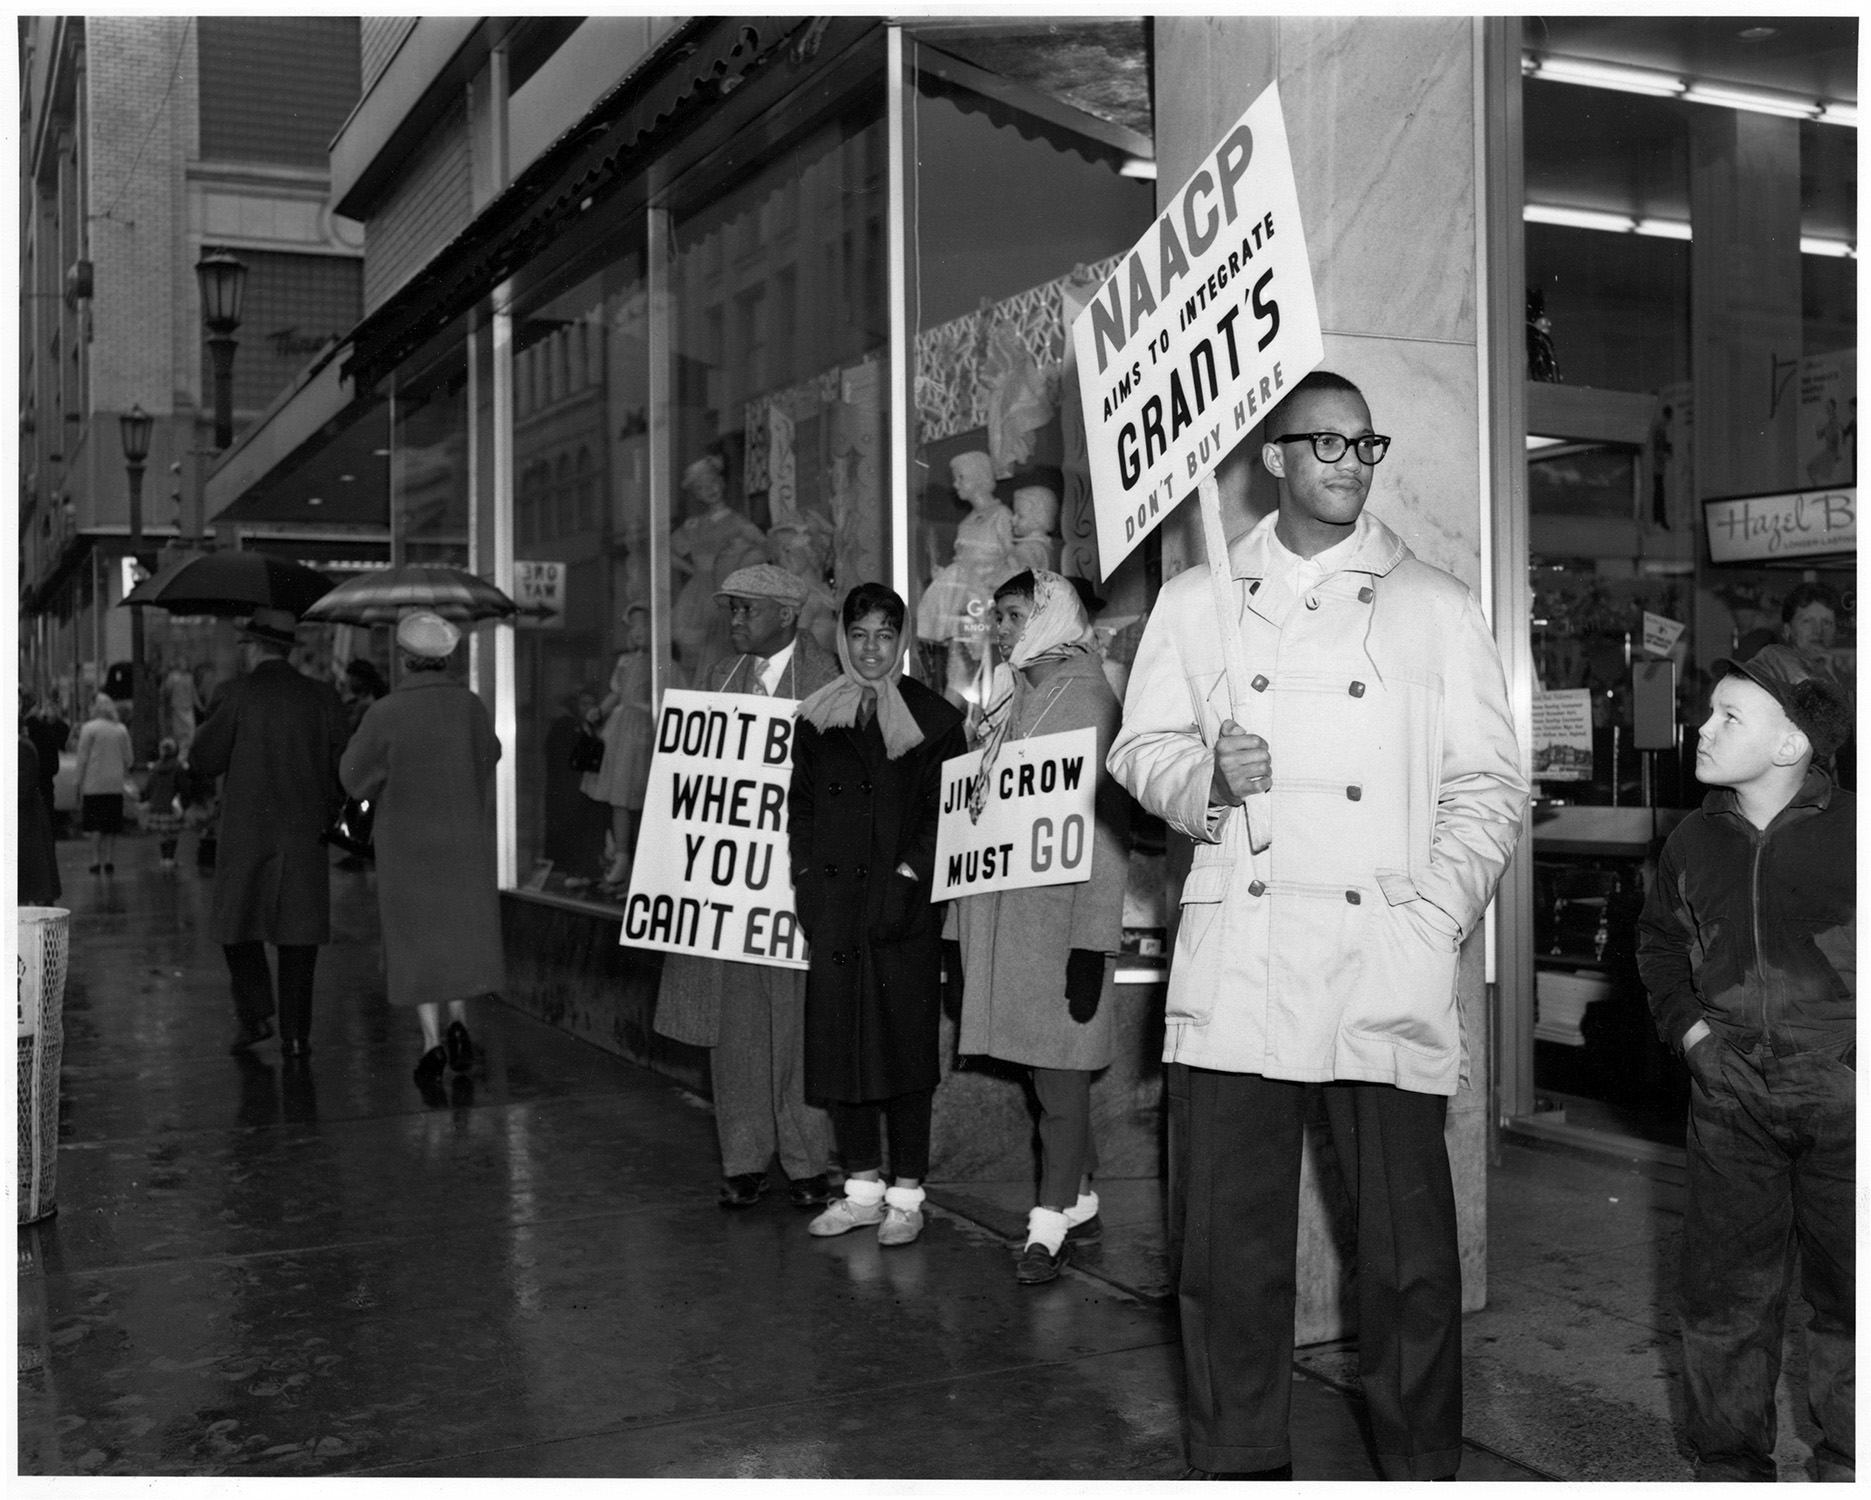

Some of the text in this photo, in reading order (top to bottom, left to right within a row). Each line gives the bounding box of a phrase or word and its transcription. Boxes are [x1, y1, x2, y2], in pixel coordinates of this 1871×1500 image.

[1091, 125, 1254, 375] NAACP
[1103, 211, 1275, 424] AIMS TO INTEGRATE
[1117, 267, 1281, 492] GRANT'S
[1125, 361, 1285, 544] DON'T BUY HERE
[1718, 494, 1855, 552] Hazel B
[658, 705, 792, 765] DON'T B
[672, 773, 786, 832] WHER
[1000, 756, 1085, 801] CROW
[684, 833, 774, 891] YOU
[946, 814, 1085, 888] MUST GO
[625, 893, 810, 961] CAN'T EA
